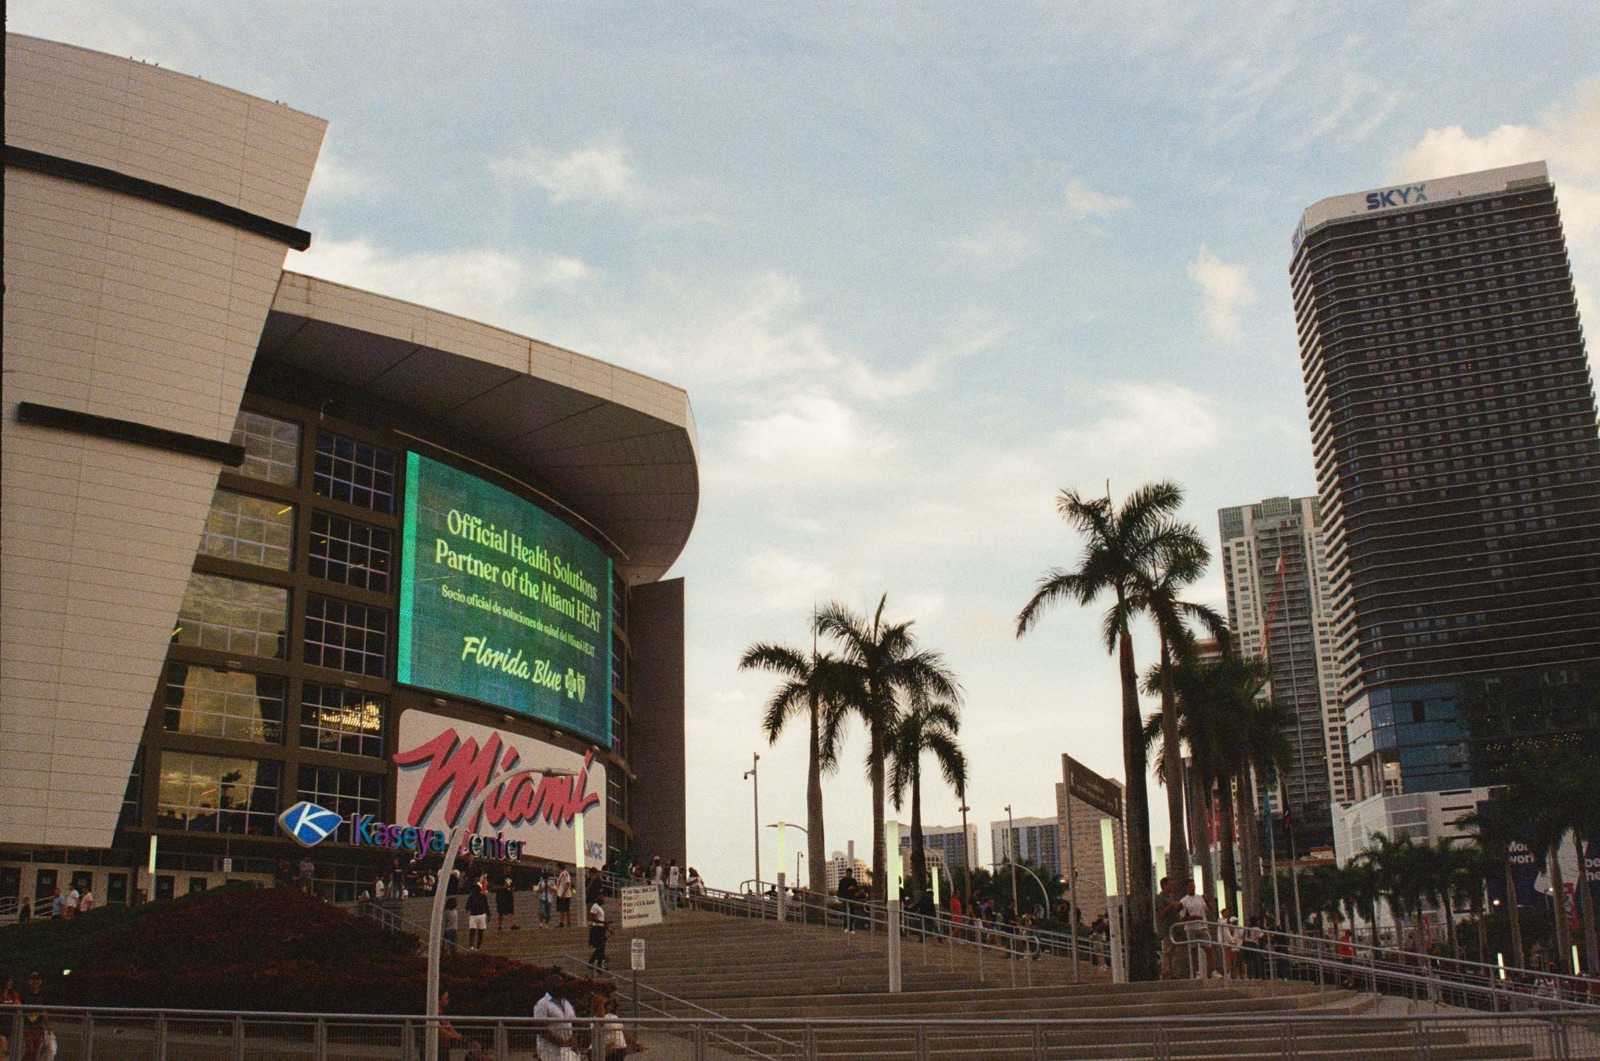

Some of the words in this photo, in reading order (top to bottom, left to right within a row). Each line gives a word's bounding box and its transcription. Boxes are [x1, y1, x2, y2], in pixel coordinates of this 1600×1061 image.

[1366, 184, 1427, 210] SKYX
[447, 509, 508, 554] Official
[510, 533, 551, 575] Health
[553, 556, 598, 602] Solutions
[435, 538, 500, 583] Partner
[501, 566, 518, 591] of
[519, 572, 539, 600] the
[541, 581, 576, 619] Miami
[576, 600, 601, 633] HEAT
[441, 584, 466, 603] Socio
[466, 594, 492, 611] oficial
[492, 601, 501, 615] de
[502, 607, 536, 629] soluciones
[537, 618, 544, 632] de
[461, 636, 531, 679] Florida
[532, 660, 562, 691] Blue
[392, 727, 600, 849] Miami
[350, 812, 445, 860] Kaseya
